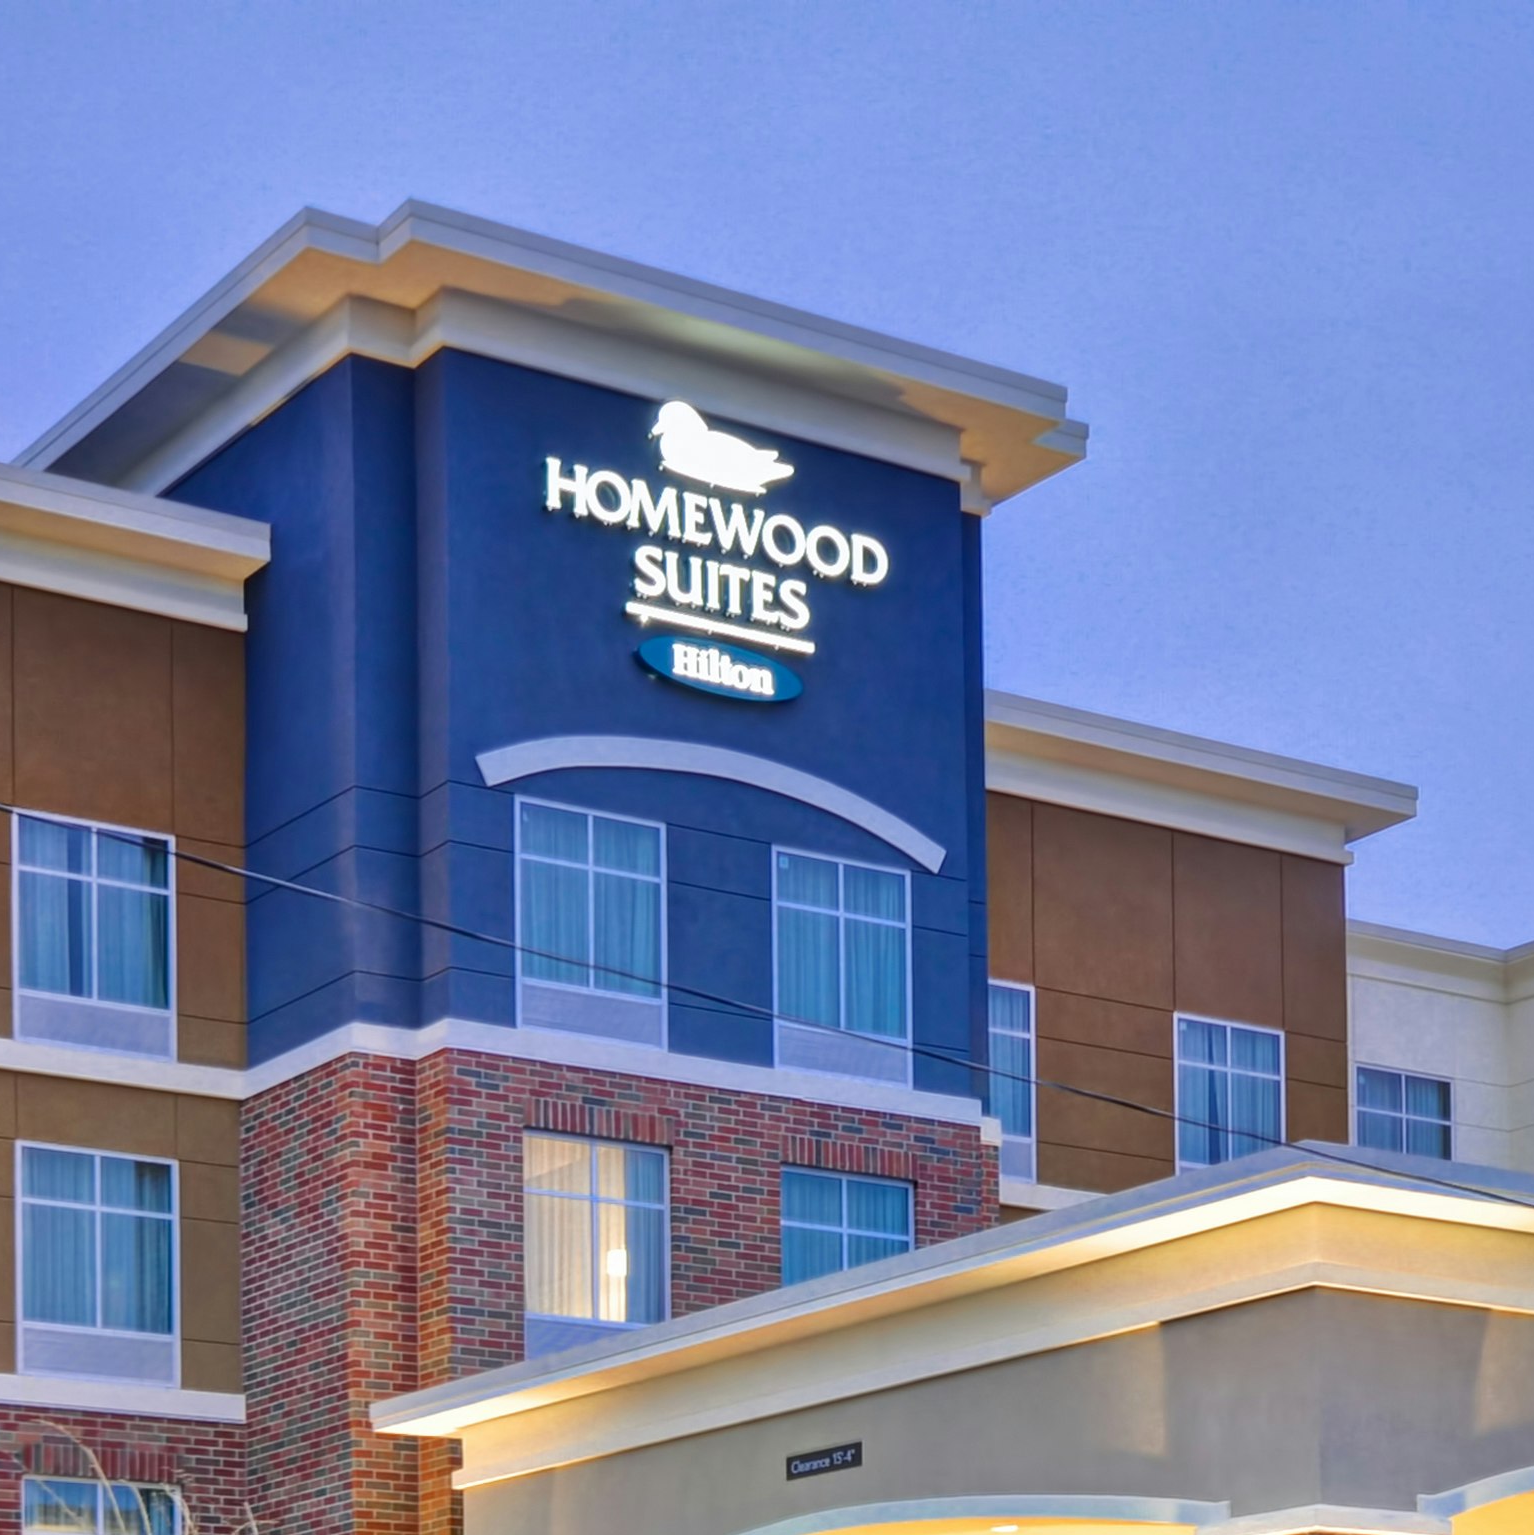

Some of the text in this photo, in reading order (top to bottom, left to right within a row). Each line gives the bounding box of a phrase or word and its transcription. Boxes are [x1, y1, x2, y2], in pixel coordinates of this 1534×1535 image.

[545, 456, 889, 586] HOMEWOOD
[633, 545, 811, 631] SUITES
[672, 643, 775, 696] Hilton
